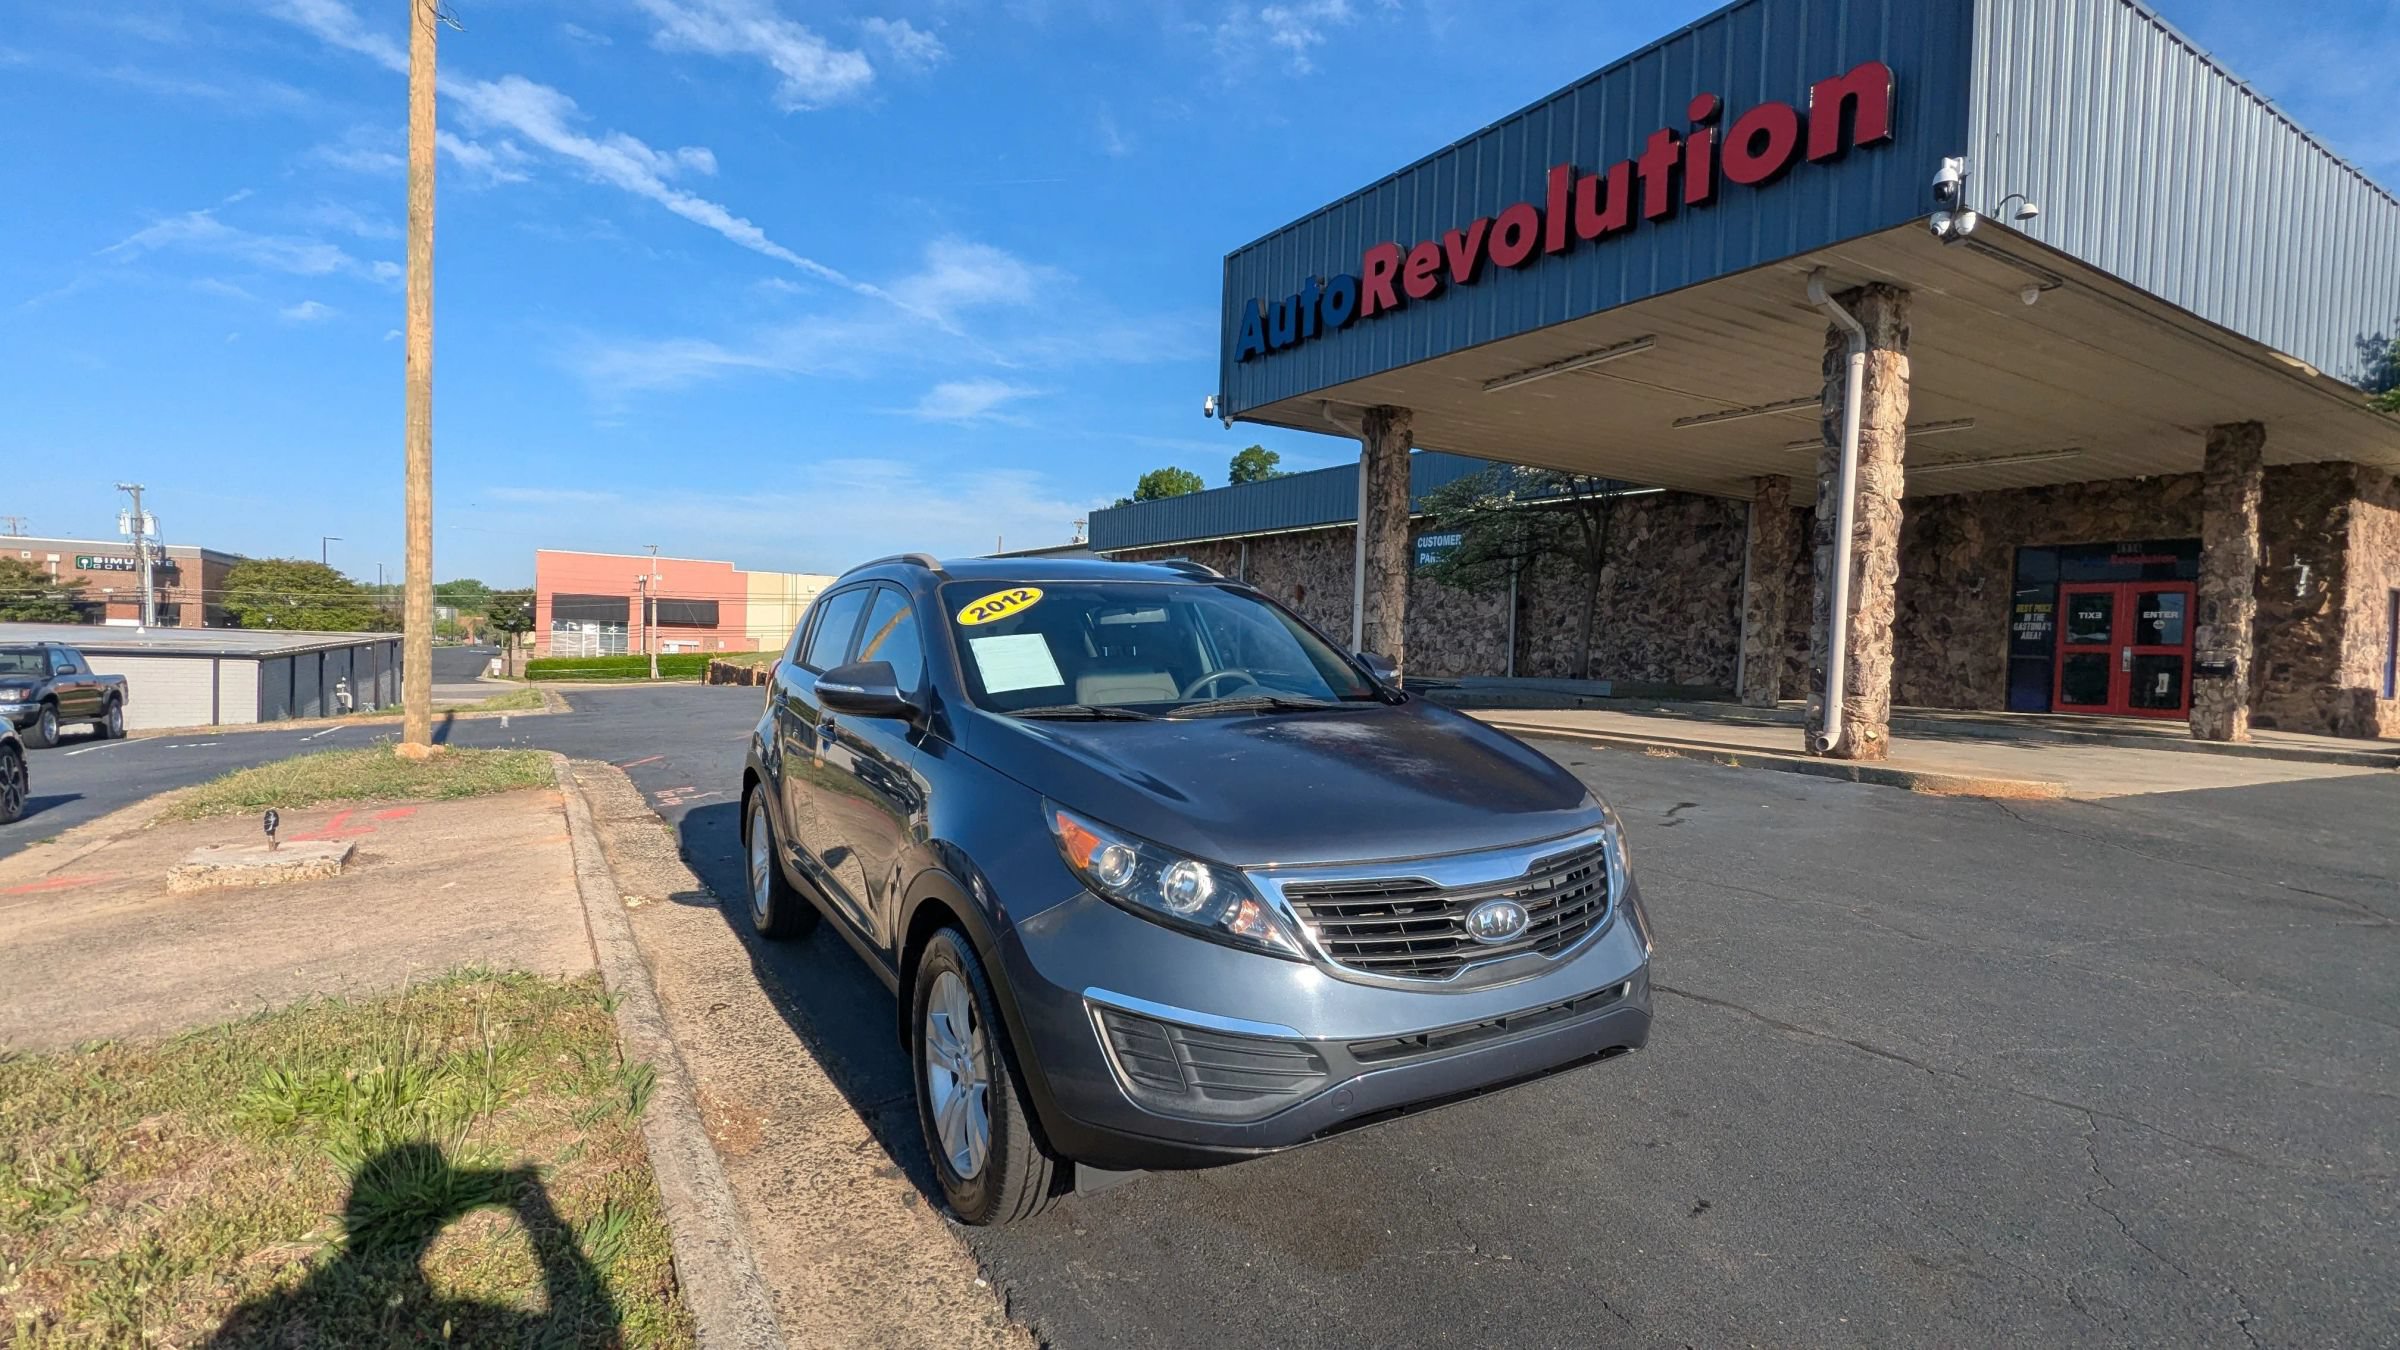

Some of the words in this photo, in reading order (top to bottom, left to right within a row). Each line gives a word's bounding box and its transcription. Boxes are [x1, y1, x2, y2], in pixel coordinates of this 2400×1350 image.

[1234, 60, 1894, 363] AutoRevolution
[1417, 534, 1462, 548] CUSTOMER
[969, 590, 1034, 621] 2012
[2143, 611, 2179, 619] ENTER
[2033, 613, 2046, 622] THE
[1478, 908, 1518, 933] KIA
